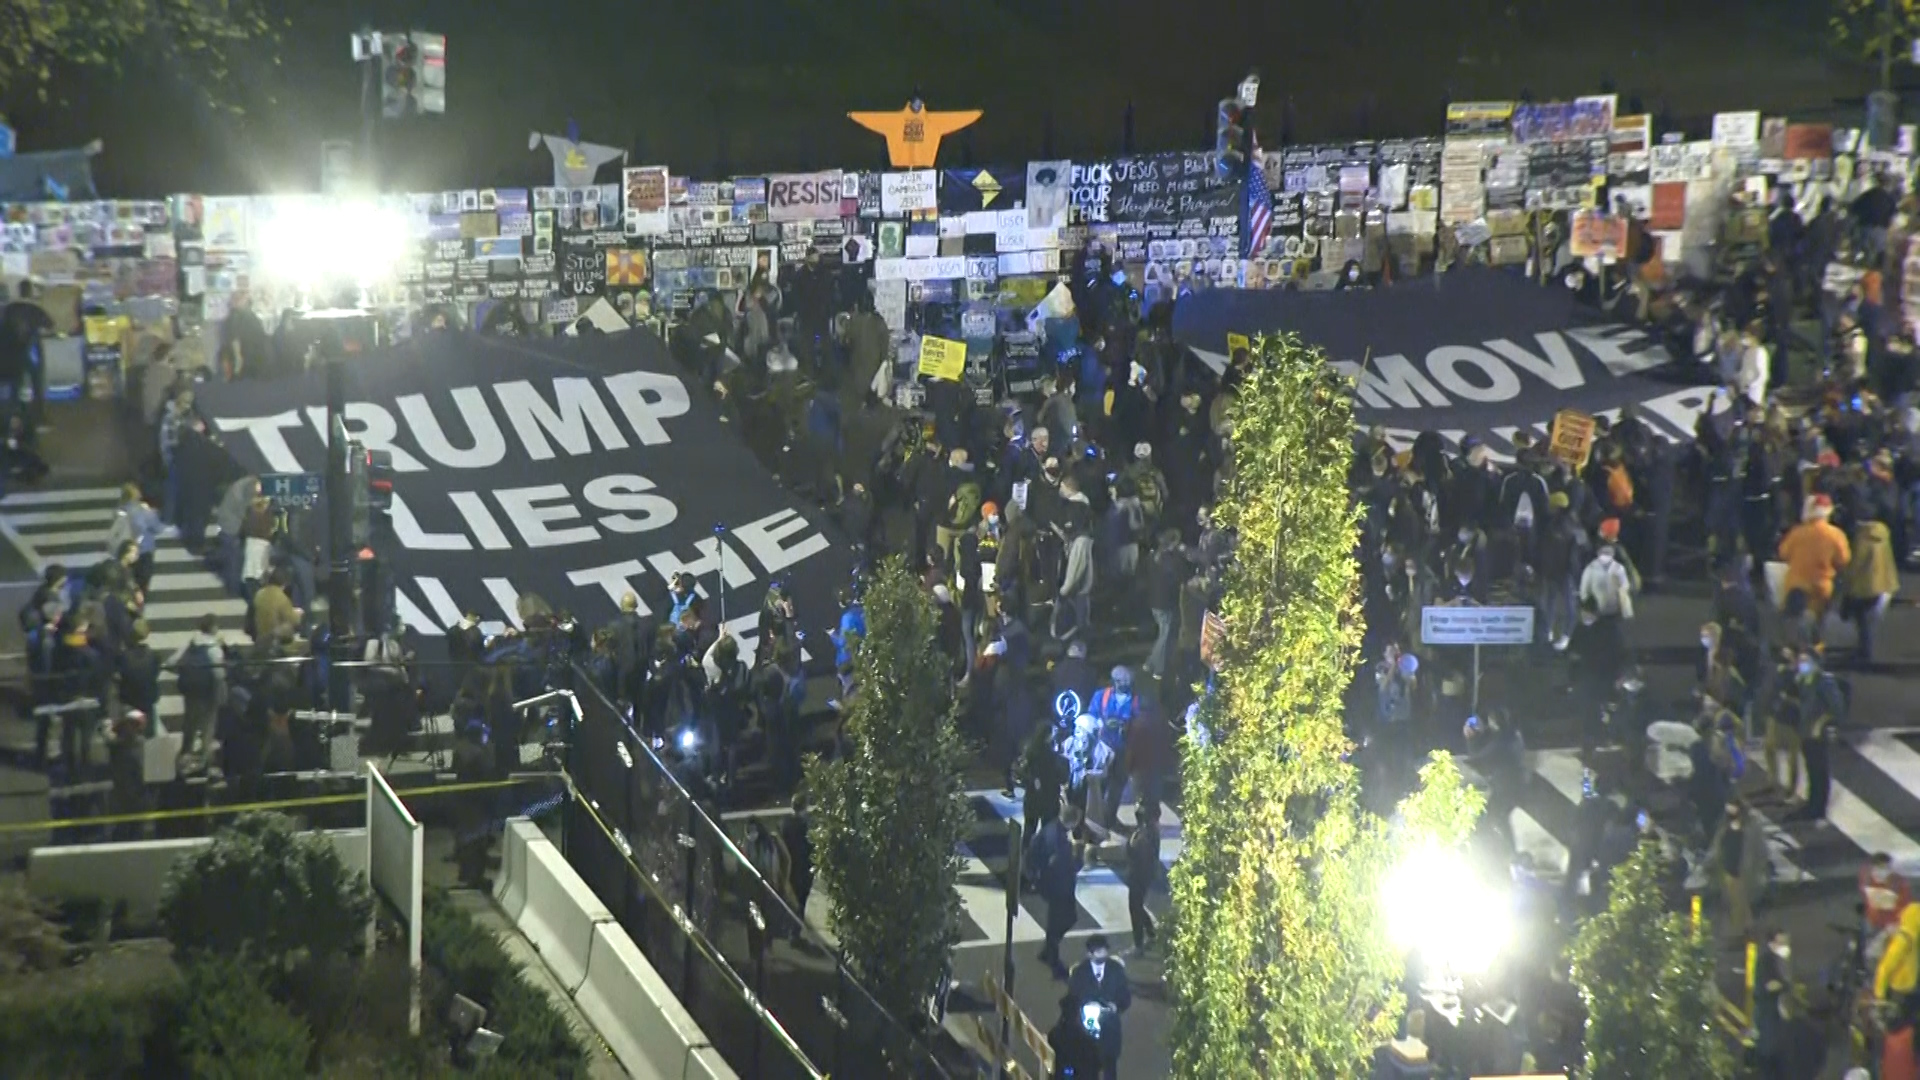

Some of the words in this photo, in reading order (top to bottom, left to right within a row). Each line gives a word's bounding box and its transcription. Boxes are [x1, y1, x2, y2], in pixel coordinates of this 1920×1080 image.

[900, 172, 922, 182] JOIN
[1071, 164, 1112, 184] FUCK
[1115, 160, 1158, 182] JESUS
[770, 179, 842, 208] RESIST
[1069, 185, 1112, 203] YOUR
[1133, 181, 1159, 194] NEED
[1069, 204, 1109, 223] FENCE
[563, 269, 605, 283] KILLING
[574, 281, 595, 294] US
[213, 370, 691, 474] TRUMP
[276, 479, 291, 494] H
[384, 472, 679, 551] LIES
[565, 507, 830, 618] THE
